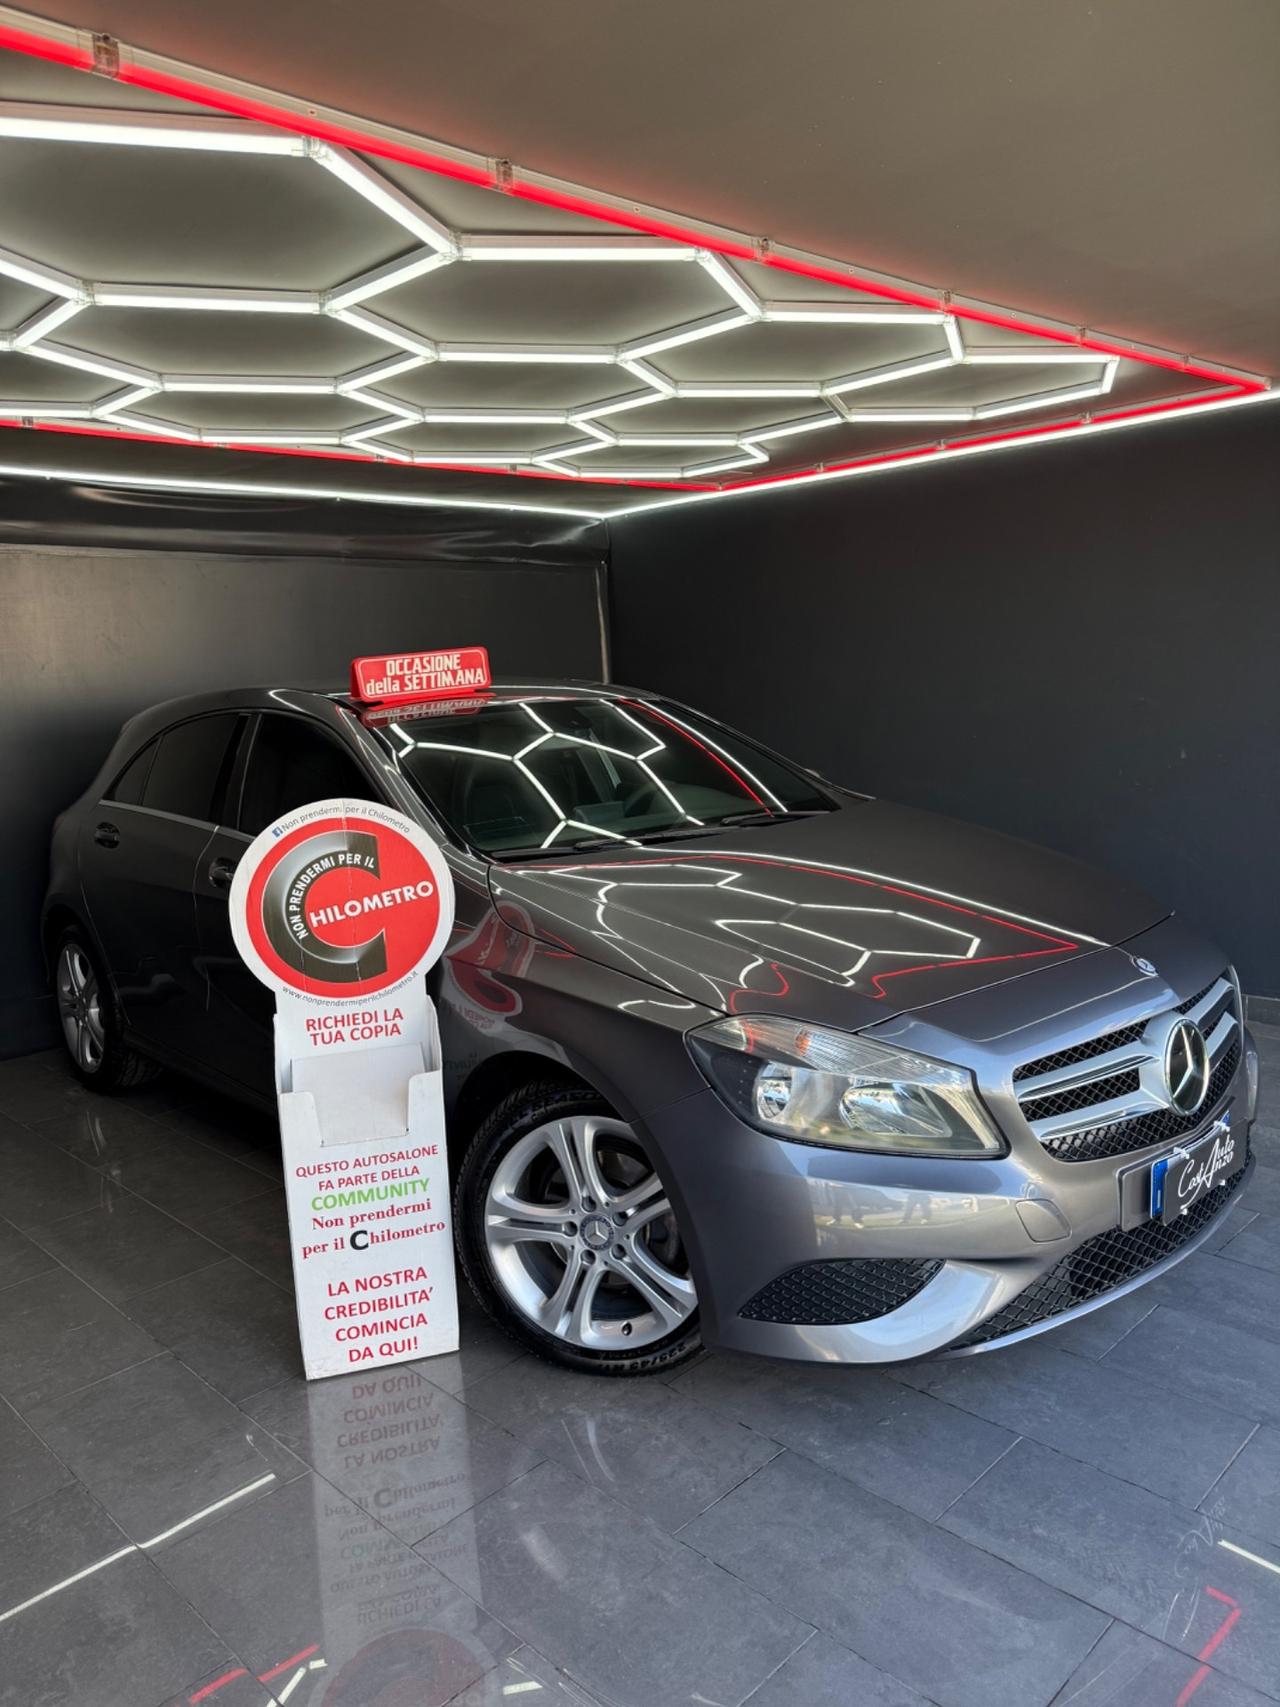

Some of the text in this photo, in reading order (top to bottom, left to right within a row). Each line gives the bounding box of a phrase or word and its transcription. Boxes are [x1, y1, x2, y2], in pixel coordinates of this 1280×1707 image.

[386, 654, 461, 676] OCCASIONE
[366, 668, 485, 695] della SETTIMANA
[281, 818, 299, 832] Non
[345, 806, 360, 814] per
[368, 804, 410, 833] Chilometro
[289, 853, 375, 939] NON PRENDERMI PER IL
[306, 1008, 403, 1032] RICHIEDI LA
[310, 1023, 401, 1046] TUA COPIA
[296, 1144, 439, 1178] QUESTO AUTOSALONE
[318, 1166, 420, 1191] FA PARTE DELLA
[311, 1178, 430, 1211] COMMUNITY
[312, 1198, 432, 1230] Non prendermi
[302, 1241, 329, 1259] per
[333, 1238, 345, 1251] il
[328, 1266, 428, 1297] LA NOSTRA
[335, 1313, 428, 1342] COMINCIA
[348, 1336, 418, 1362] DA QUI!
